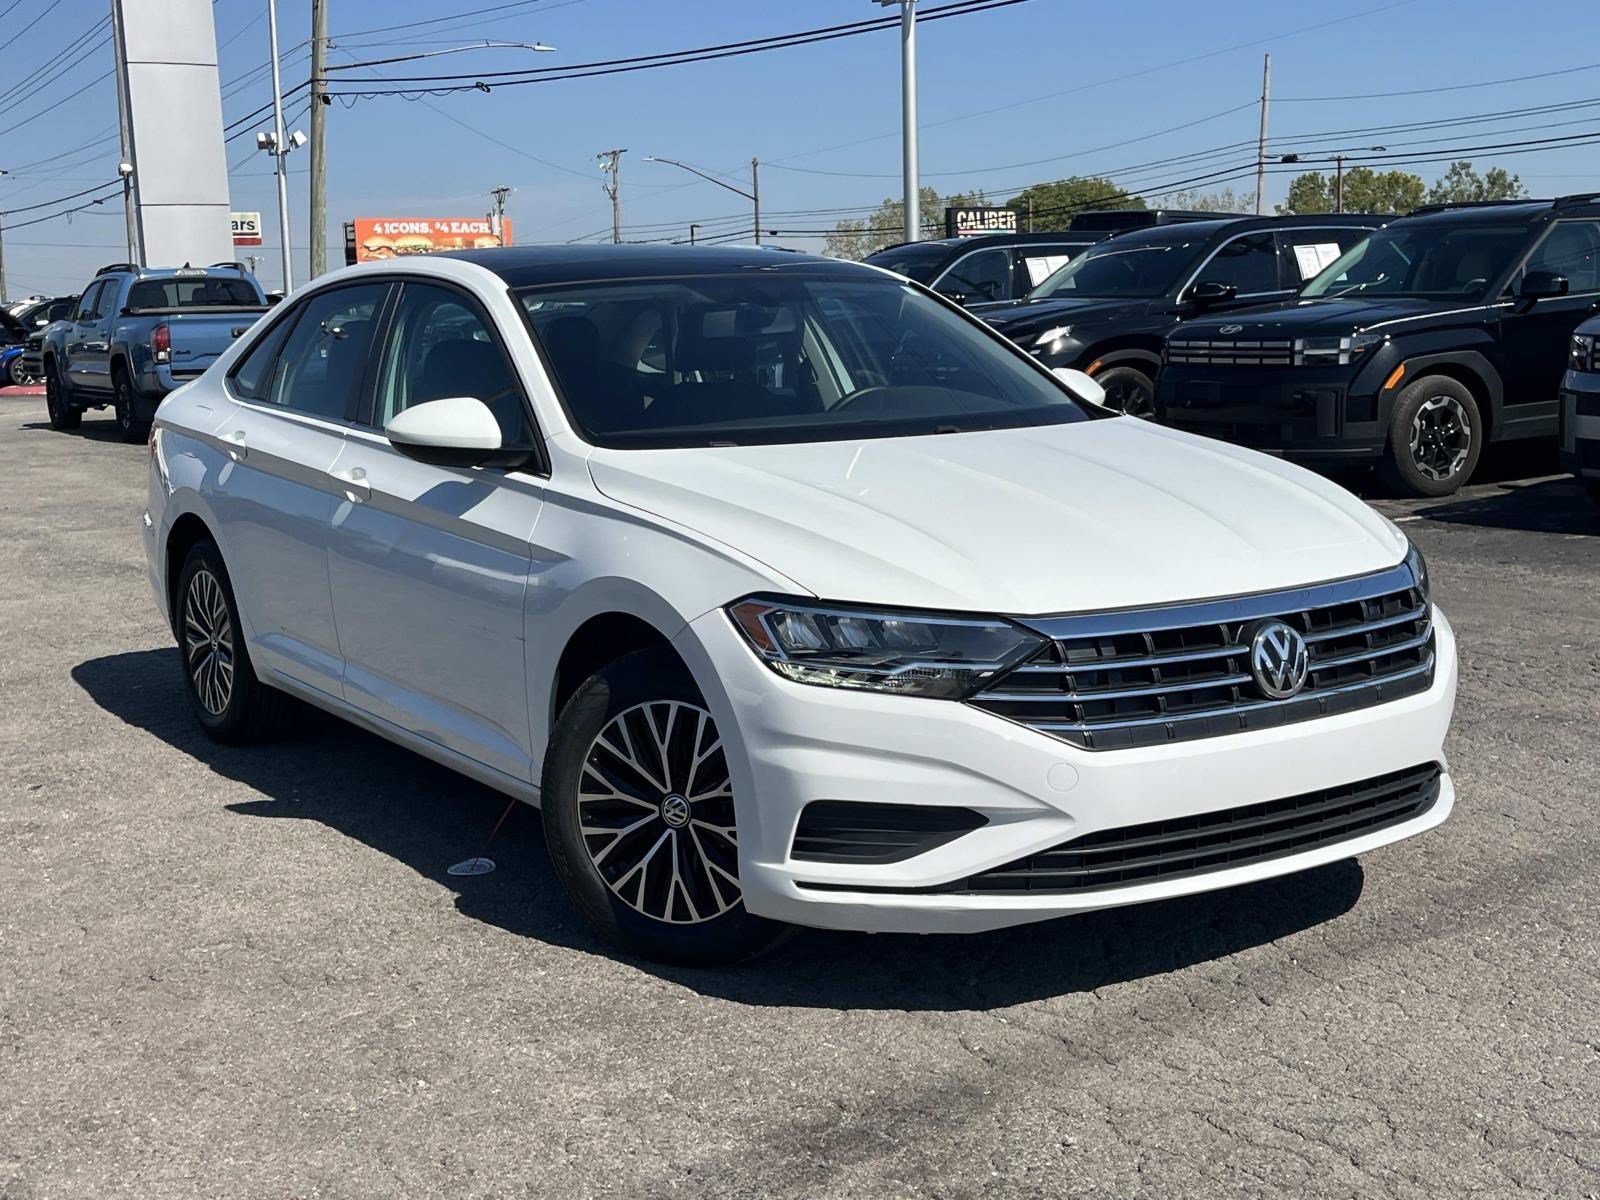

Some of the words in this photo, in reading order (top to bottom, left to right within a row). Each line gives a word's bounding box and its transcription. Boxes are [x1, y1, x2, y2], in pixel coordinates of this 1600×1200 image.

[373, 222, 382, 234] 4
[384, 222, 433, 234] ICONS.
[435, 222, 449, 233] $4
[957, 211, 1017, 230] CALIBER
